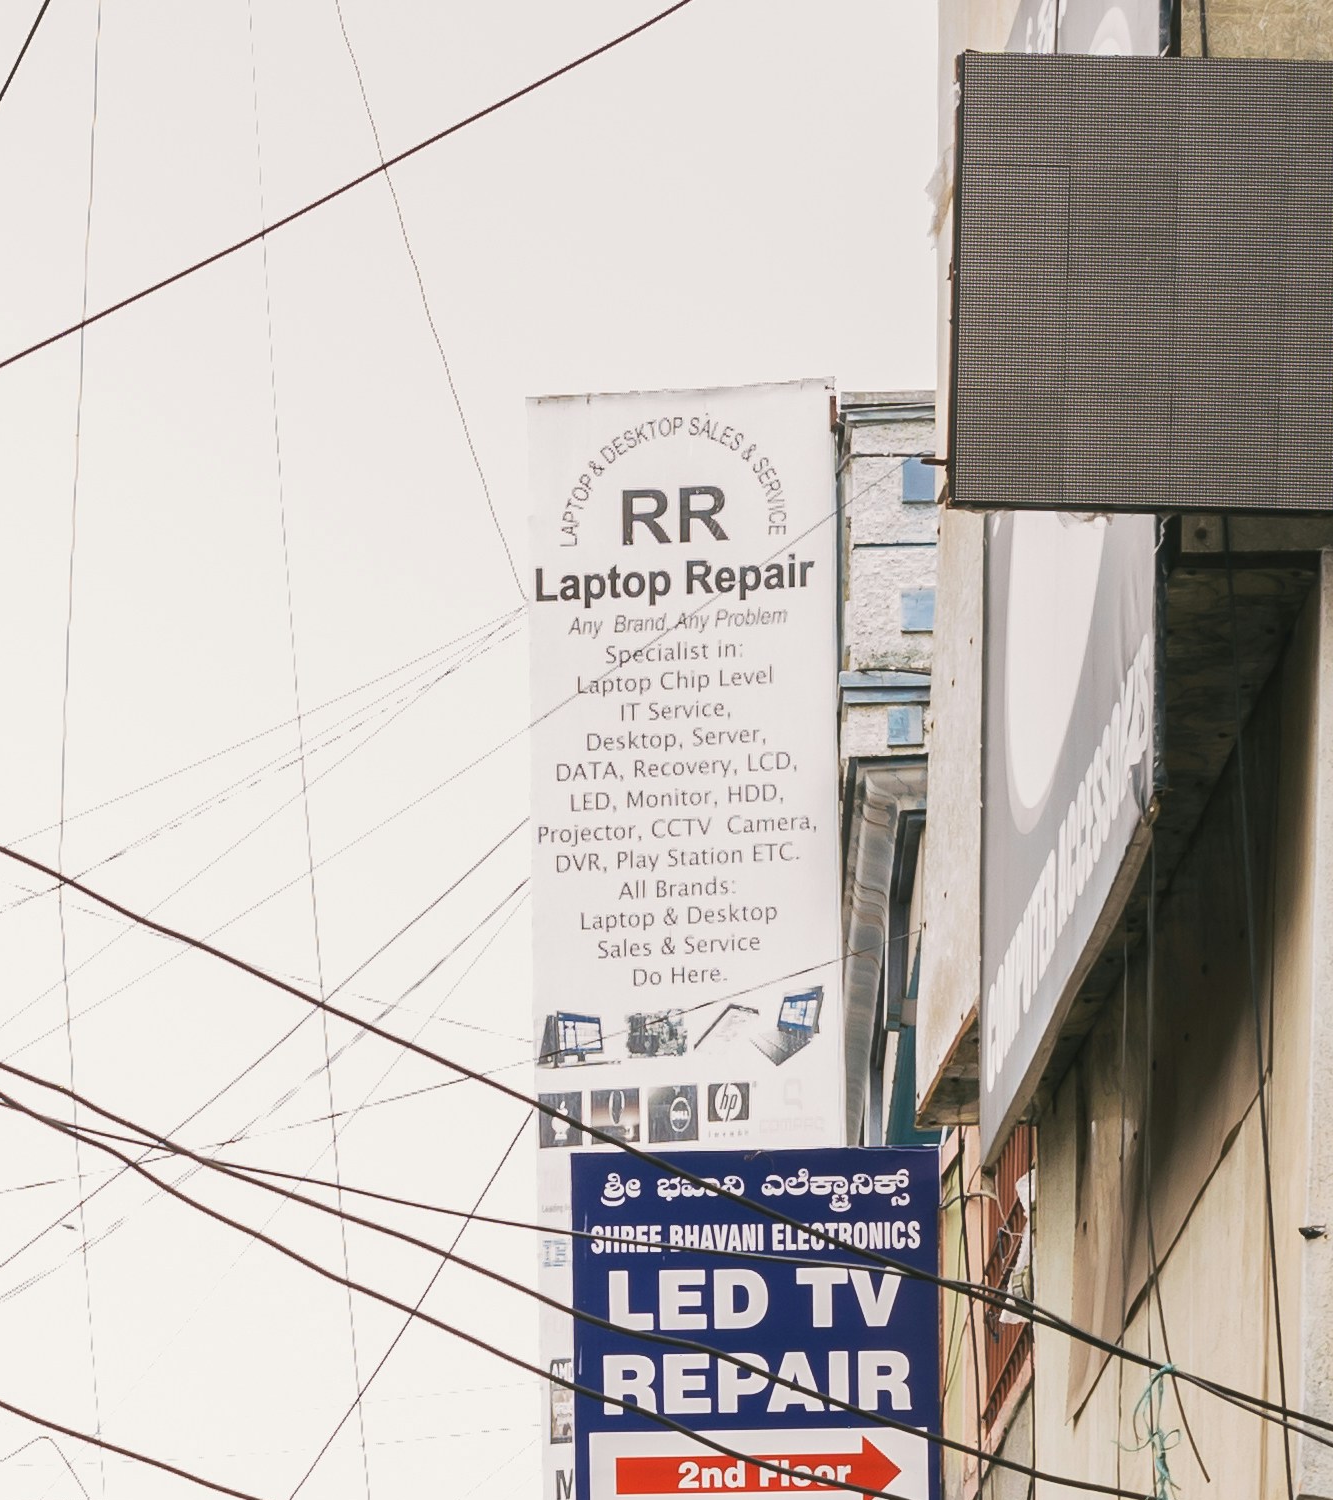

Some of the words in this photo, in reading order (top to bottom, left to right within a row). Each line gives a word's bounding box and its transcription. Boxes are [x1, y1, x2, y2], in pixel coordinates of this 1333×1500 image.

[559, 468, 594, 549] LAPTOP
[751, 454, 787, 536] SERVICE
[621, 486, 730, 547] RR
[535, 566, 671, 608] Laptop
[685, 553, 814, 599] Repair
[715, 606, 787, 628] Problem
[605, 641, 709, 668] Specialist
[576, 672, 652, 698] Laptop
[661, 669, 711, 695] Chip
[719, 664, 774, 688] Level
[620, 701, 641, 721] IT
[648, 700, 731, 722] Service,
[586, 731, 685, 756] Desktop,
[693, 727, 766, 748] Server,
[556, 761, 625, 784] DATA,
[633, 757, 738, 782] Recovery,
[747, 751, 797, 775] LCD,
[569, 791, 617, 815] LED,
[626, 787, 719, 809] Monitor,
[727, 784, 784, 806] HDD,
[537, 821, 642, 848] Projector,
[651, 818, 711, 839] CCTV
[727, 814, 817, 838] Camera,
[619, 879, 647, 900] All
[591, 1225, 663, 1254] SHREE
[671, 1223, 764, 1252] BHAVANI
[771, 1221, 921, 1250] ELECTRONICS
[609, 1269, 768, 1331] LED
[797, 1266, 902, 1328] TV
[602, 1351, 912, 1416] REPAIR
[759, 1458, 853, 1488] Floor
